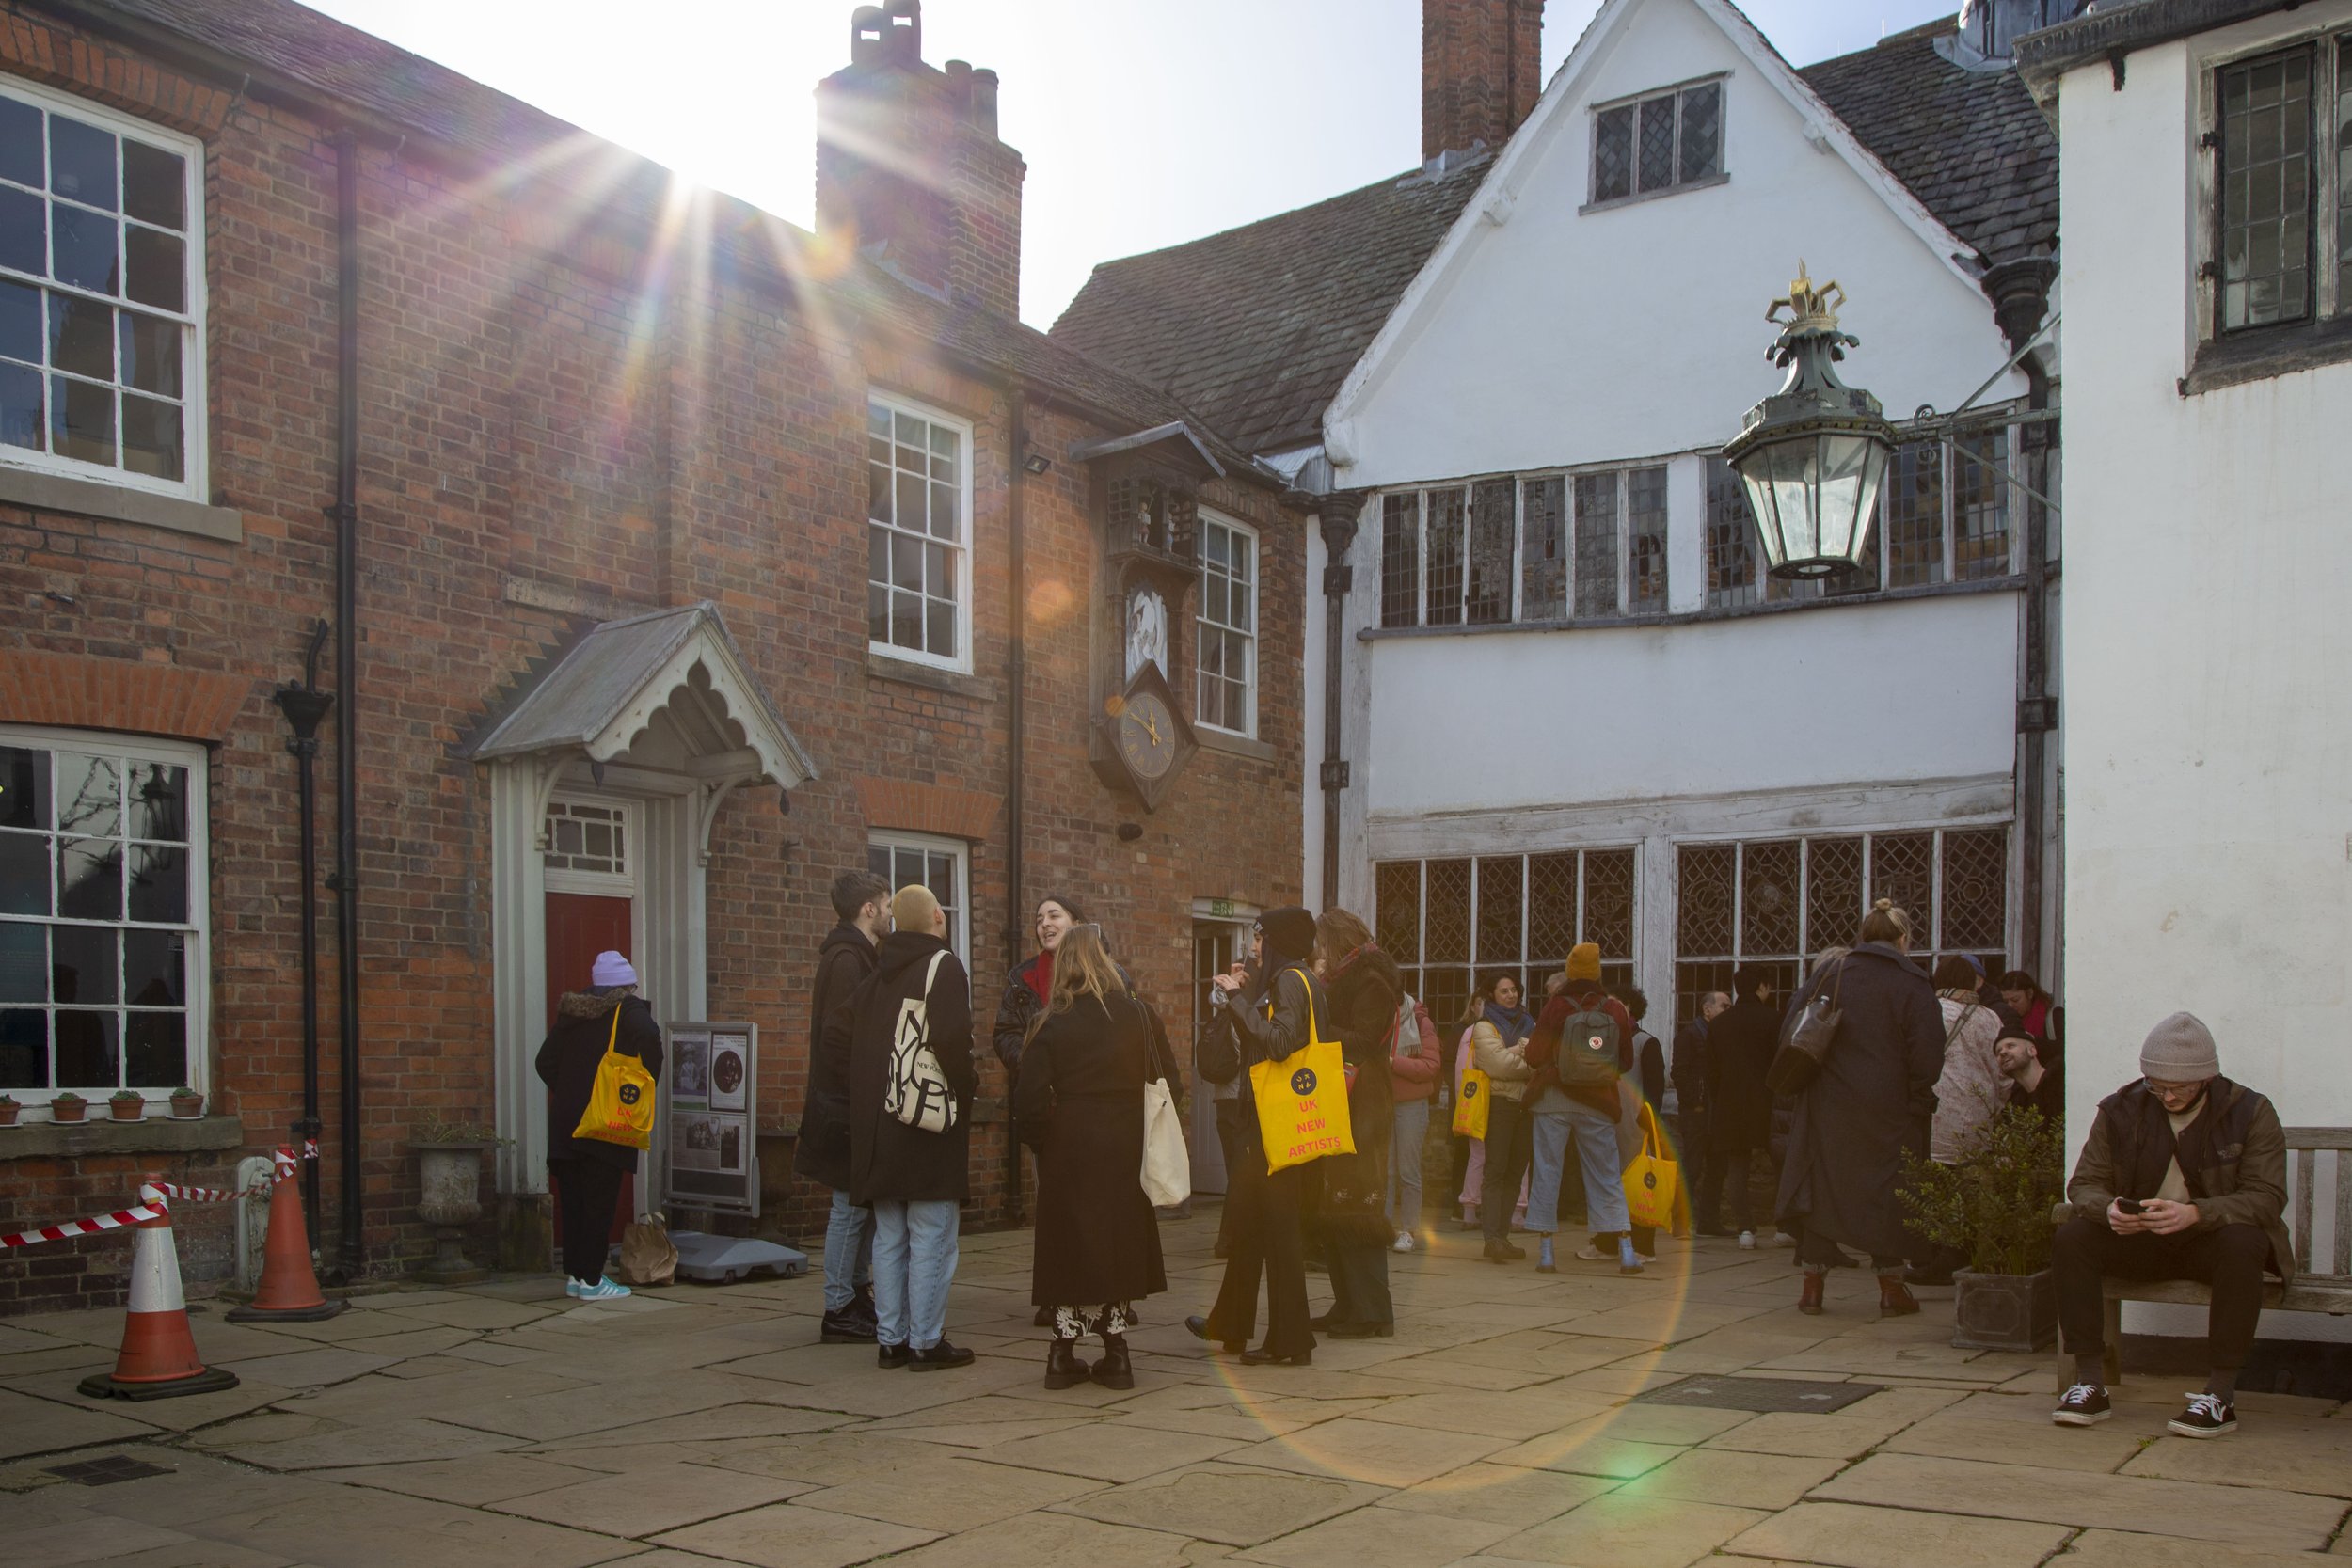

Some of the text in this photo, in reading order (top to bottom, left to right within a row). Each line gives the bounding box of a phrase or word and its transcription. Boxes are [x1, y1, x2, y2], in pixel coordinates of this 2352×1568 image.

[1299, 1099, 1318, 1113] UK
[608, 1120, 633, 1132] NEW
[1296, 1118, 1326, 1134] NEW
[1288, 1138, 1341, 1158] ARTISTS
